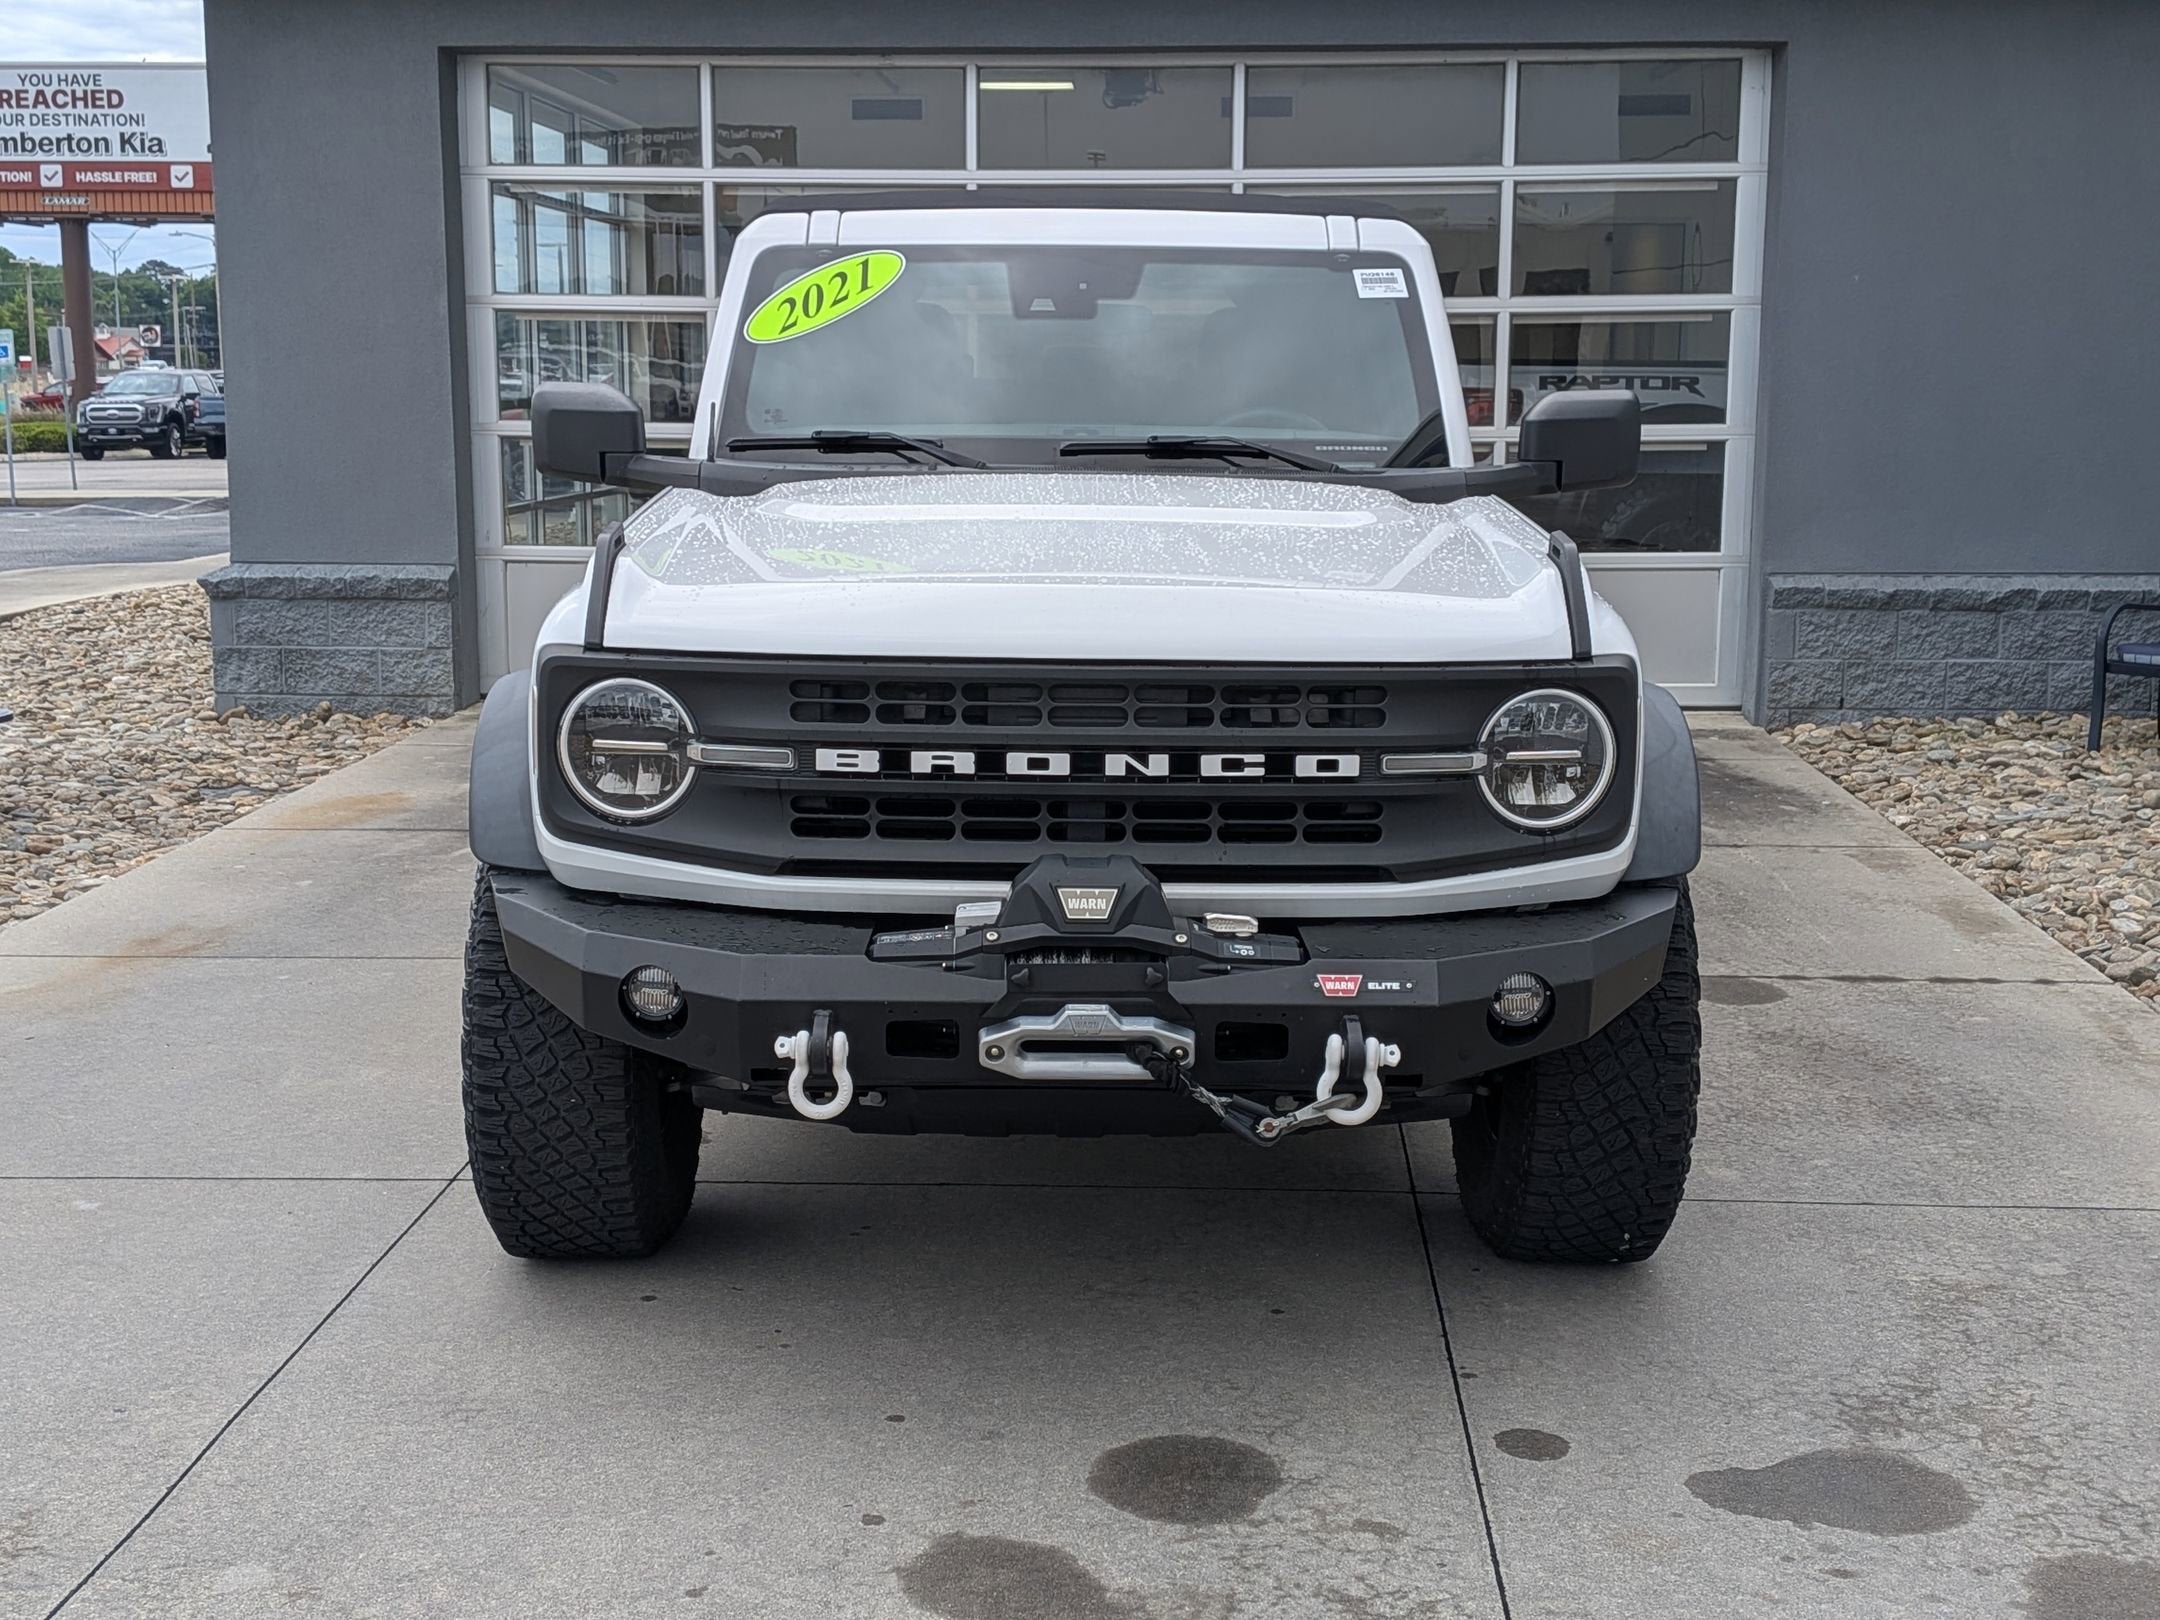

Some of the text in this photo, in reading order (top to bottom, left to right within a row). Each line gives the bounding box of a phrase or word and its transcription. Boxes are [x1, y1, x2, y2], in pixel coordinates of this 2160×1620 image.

[17, 74, 102, 87] YOU HAVE
[0, 89, 124, 109] REACHED
[30, 113, 145, 127] DESTINATION!
[119, 132, 164, 156] Kia
[75, 172, 157, 183] HASSLE FREE!
[44, 196, 87, 205] LAMAR
[777, 257, 873, 335] 2021
[1539, 375, 1705, 398] RAPTOR
[815, 748, 1361, 777] BRONCO
[1068, 898, 1106, 910] WARN
[1325, 981, 1401, 990] WARN ELITE
